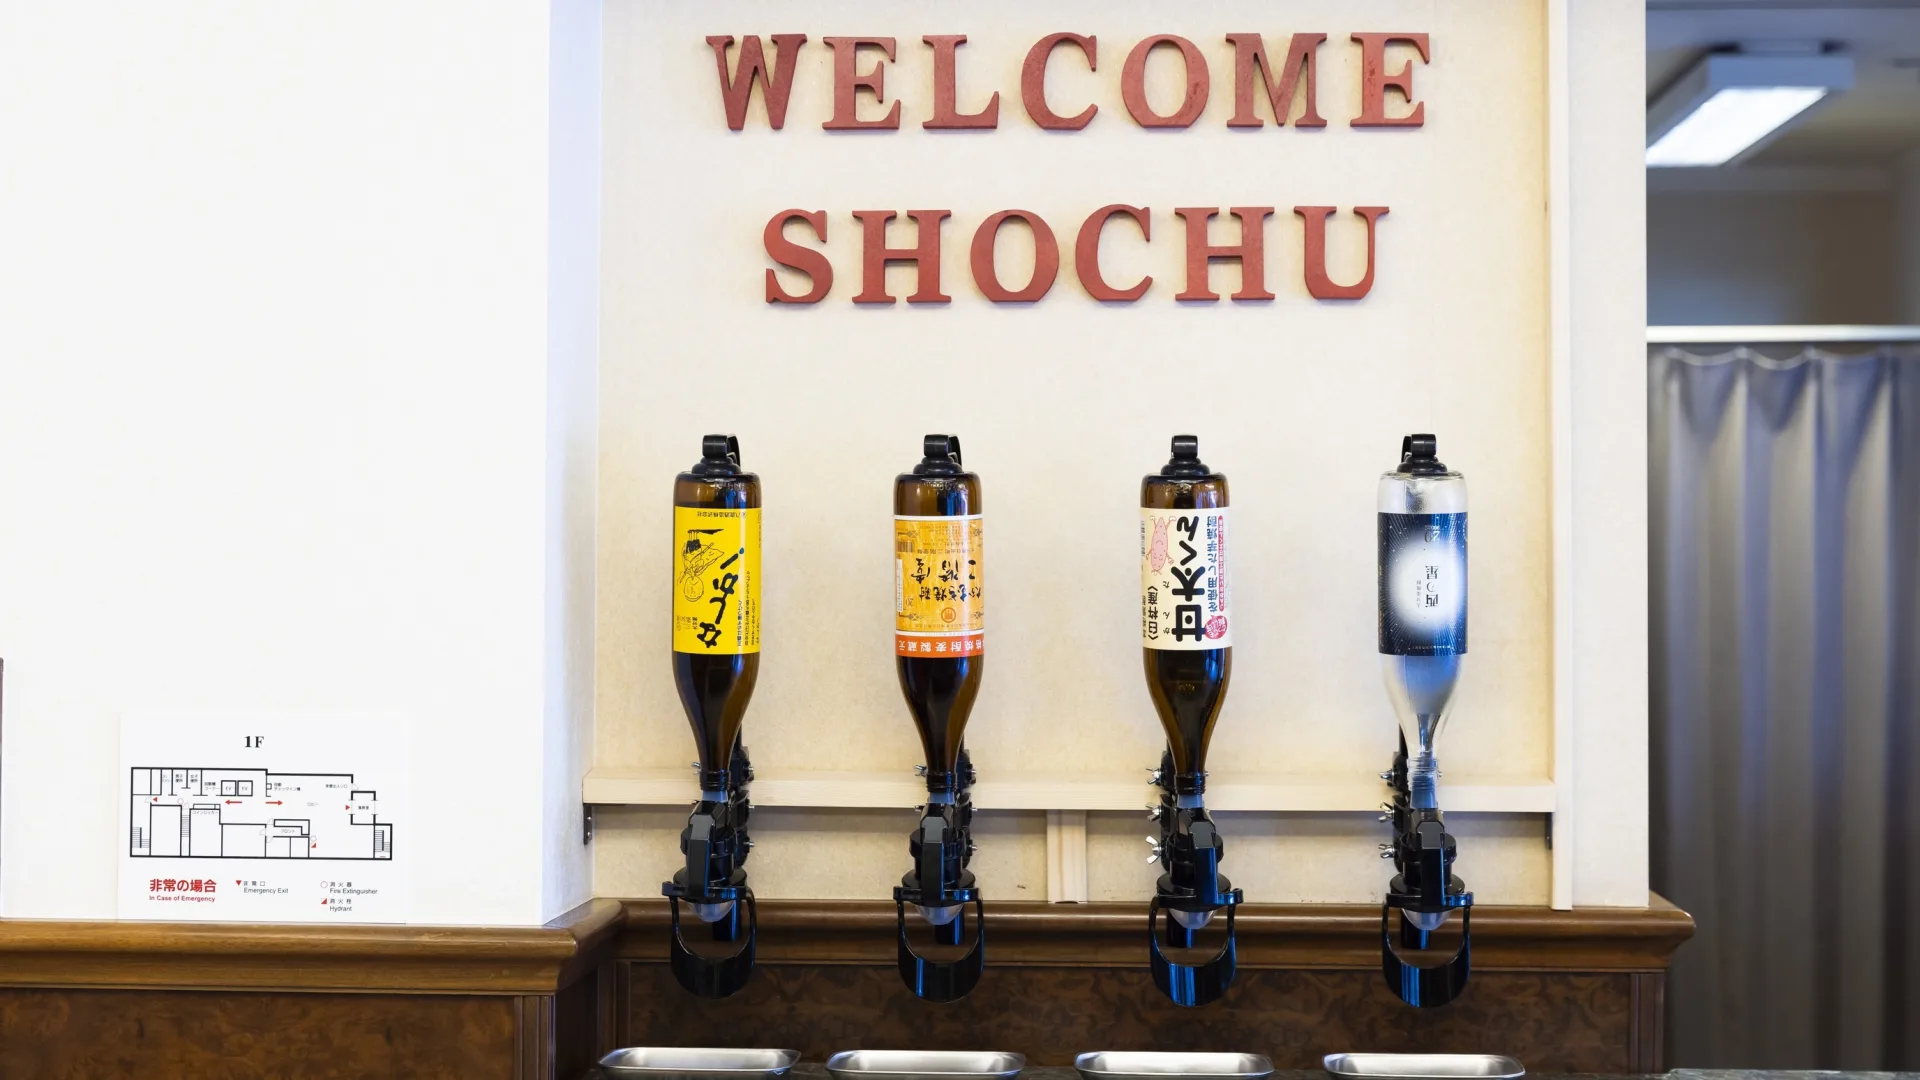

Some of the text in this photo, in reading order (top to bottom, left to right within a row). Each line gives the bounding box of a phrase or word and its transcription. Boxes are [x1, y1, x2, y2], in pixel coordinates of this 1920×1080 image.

[705, 32, 1430, 131] WELCOME
[763, 204, 1391, 305] SHOCHU
[1171, 515, 1206, 643] 甘太くん
[1206, 515, 1218, 613] を使用した芋焼酎
[1424, 564, 1440, 609] 西の星
[244, 735, 265, 748] 1F
[149, 878, 217, 893] 非常の場合
[181, 895, 216, 903] Emergency
